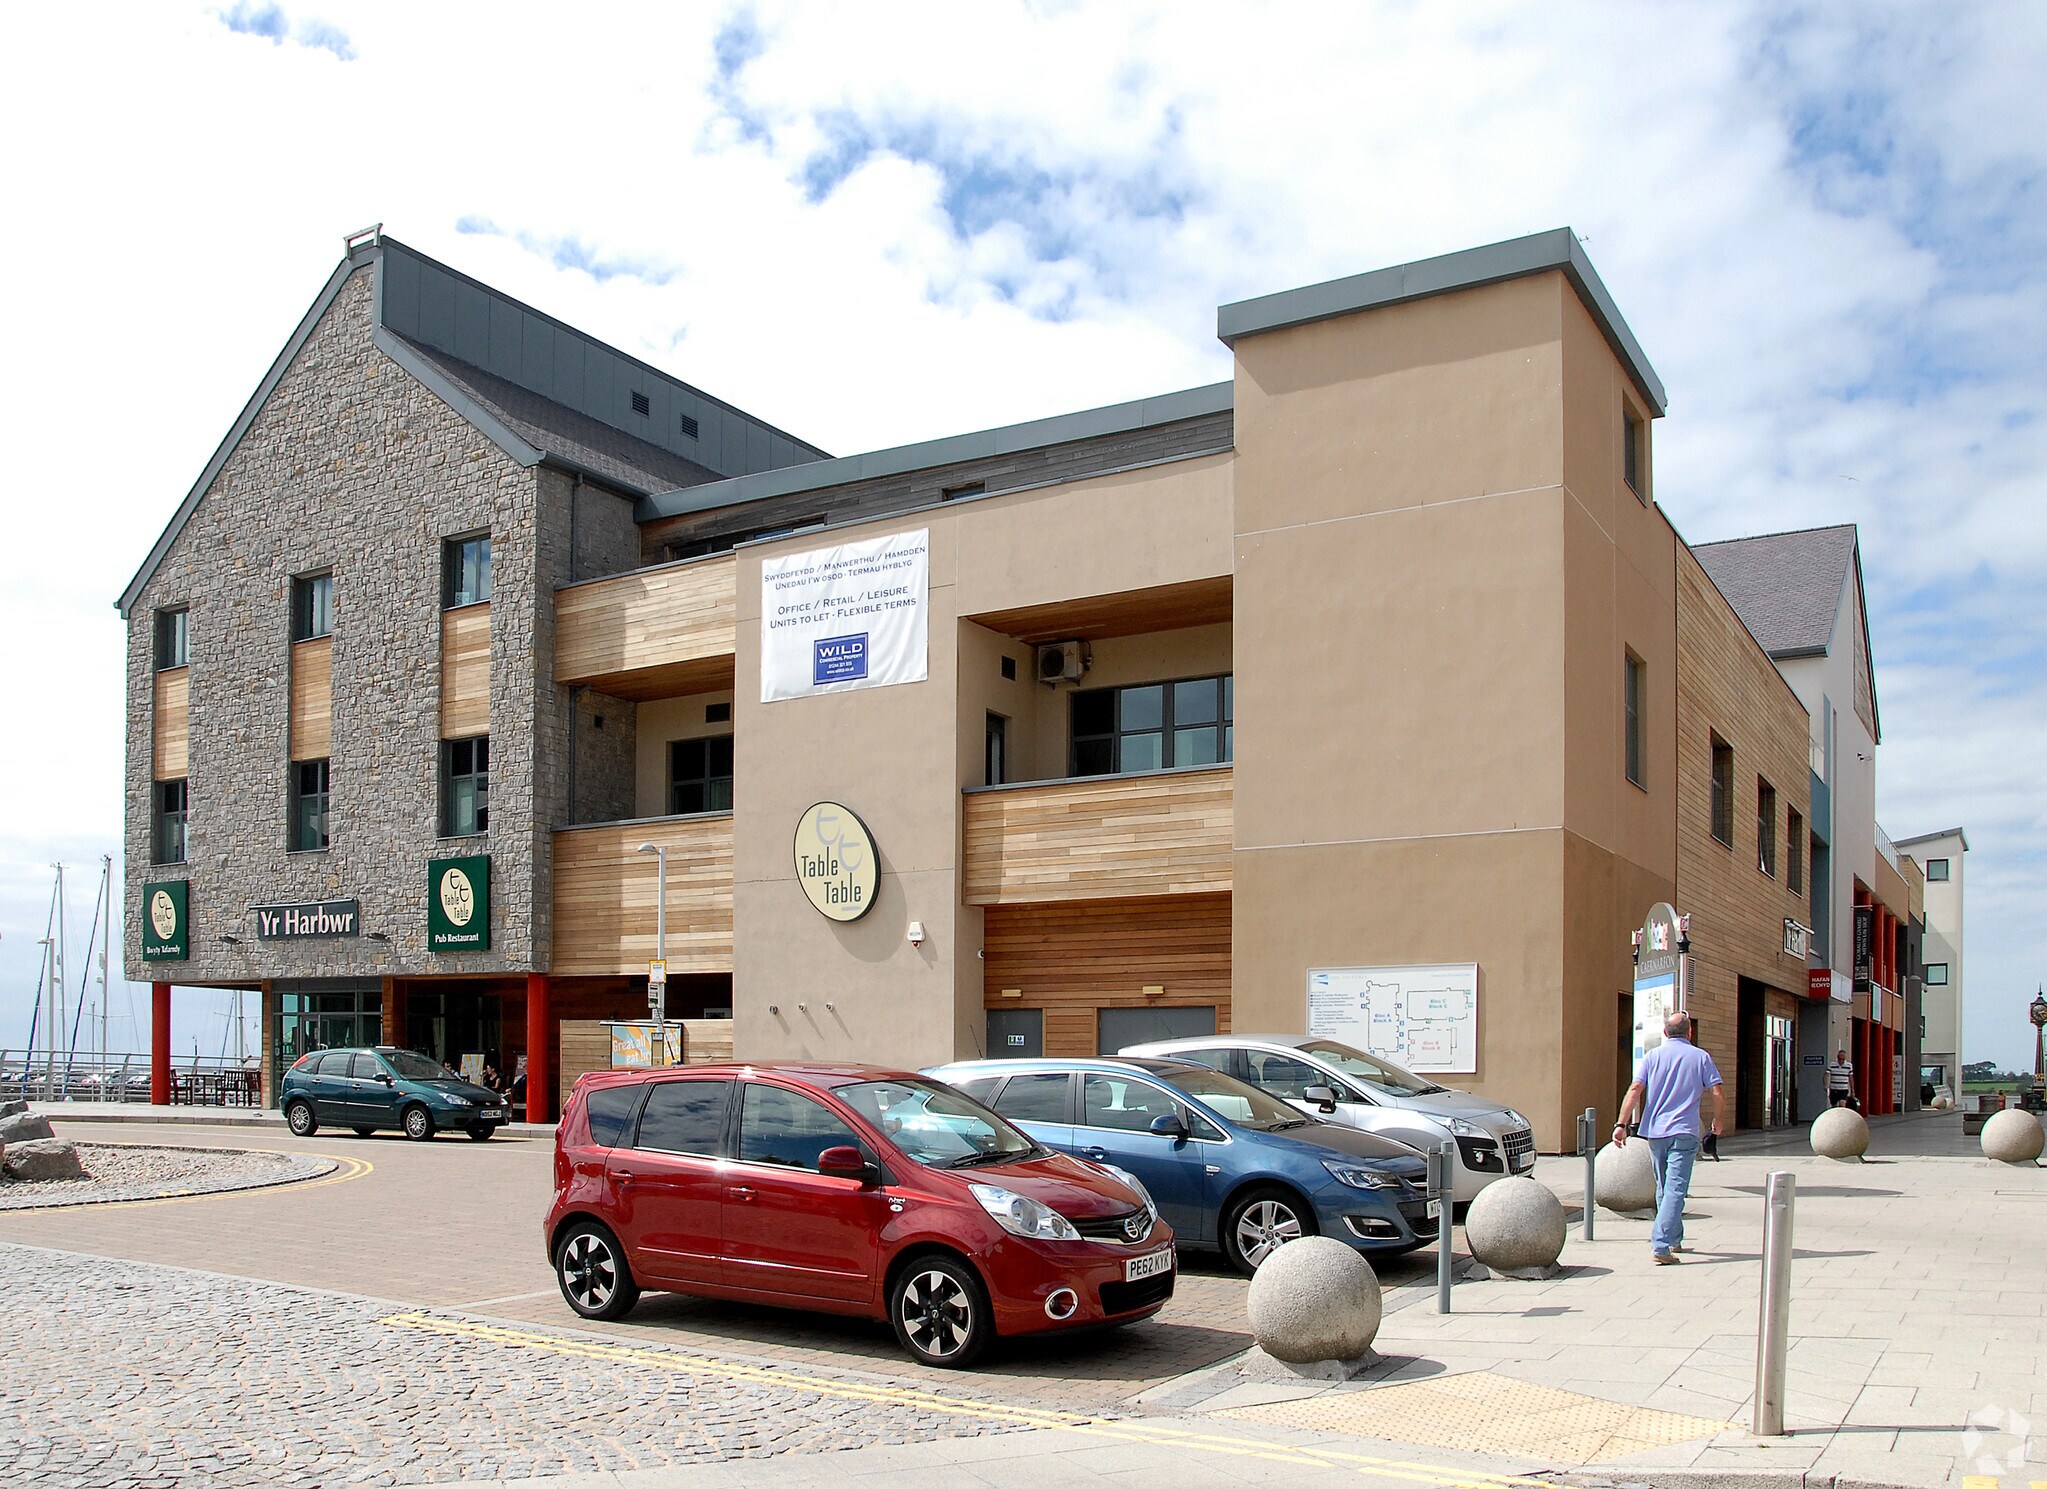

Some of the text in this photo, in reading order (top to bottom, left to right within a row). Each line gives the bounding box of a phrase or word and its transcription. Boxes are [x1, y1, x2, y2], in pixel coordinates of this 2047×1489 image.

[764, 567, 815, 582] SWYDDFEYDD
[823, 556, 875, 571] MANWERTHU
[884, 546, 926, 560] HAMDDEN
[775, 577, 806, 590] UNEDAU
[821, 573, 843, 582] OSOD
[848, 565, 881, 577] TERMAU
[882, 559, 912, 571] HYBLYG
[770, 617, 797, 629] UNITS
[800, 615, 811, 624] TO
[813, 612, 830, 622] LET
[837, 603, 882, 618] FLEXIBLE
[884, 598, 917, 610] TERMS
[777, 602, 811, 615] OFFICE
[823, 595, 855, 607] RETAIL
[867, 586, 909, 600] LEISURE
[819, 642, 863, 657] WILD
[801, 846, 838, 878] Table
[444, 890, 459, 906] Table
[824, 872, 861, 904] Table
[260, 905, 354, 936] Yr Harbwr
[453, 903, 469, 919] Table
[435, 932, 479, 943] Pub Restaurant
[1130, 1251, 1169, 1277] PE62 KYK
